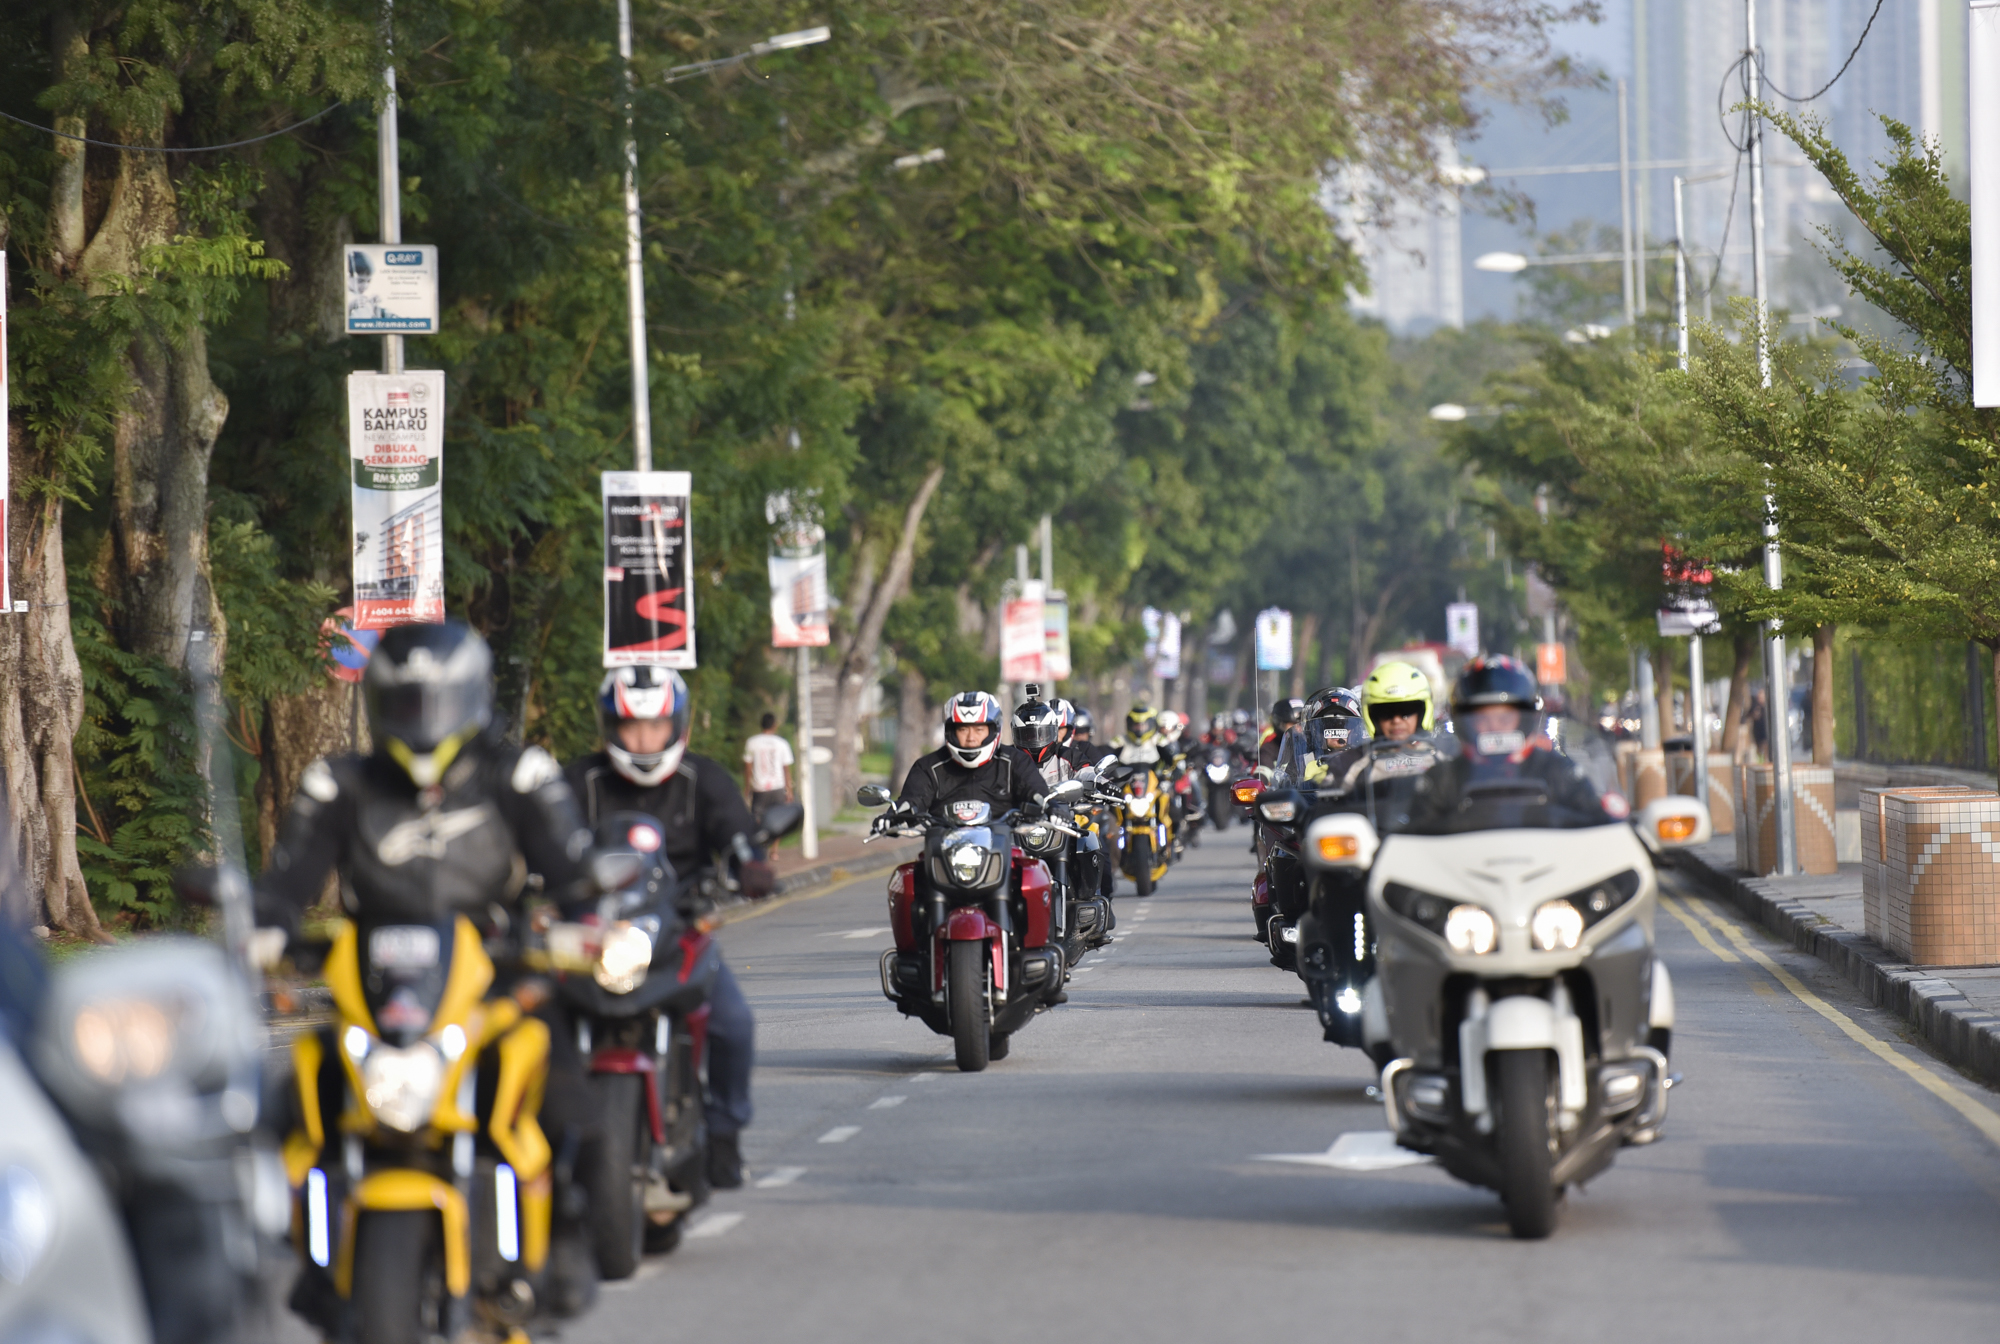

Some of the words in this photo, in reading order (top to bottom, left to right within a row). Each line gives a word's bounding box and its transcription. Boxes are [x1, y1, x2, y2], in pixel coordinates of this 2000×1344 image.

[354, 320, 427, 328] www.itramas.com
[363, 407, 427, 419] KAMPUS
[364, 420, 427, 431] BAHARU
[364, 433, 385, 441] NEW
[388, 432, 426, 441] CAMPUS
[374, 444, 417, 453] DIBUKA
[364, 455, 428, 465] SEKARANG
[372, 472, 420, 483] RM5,000
